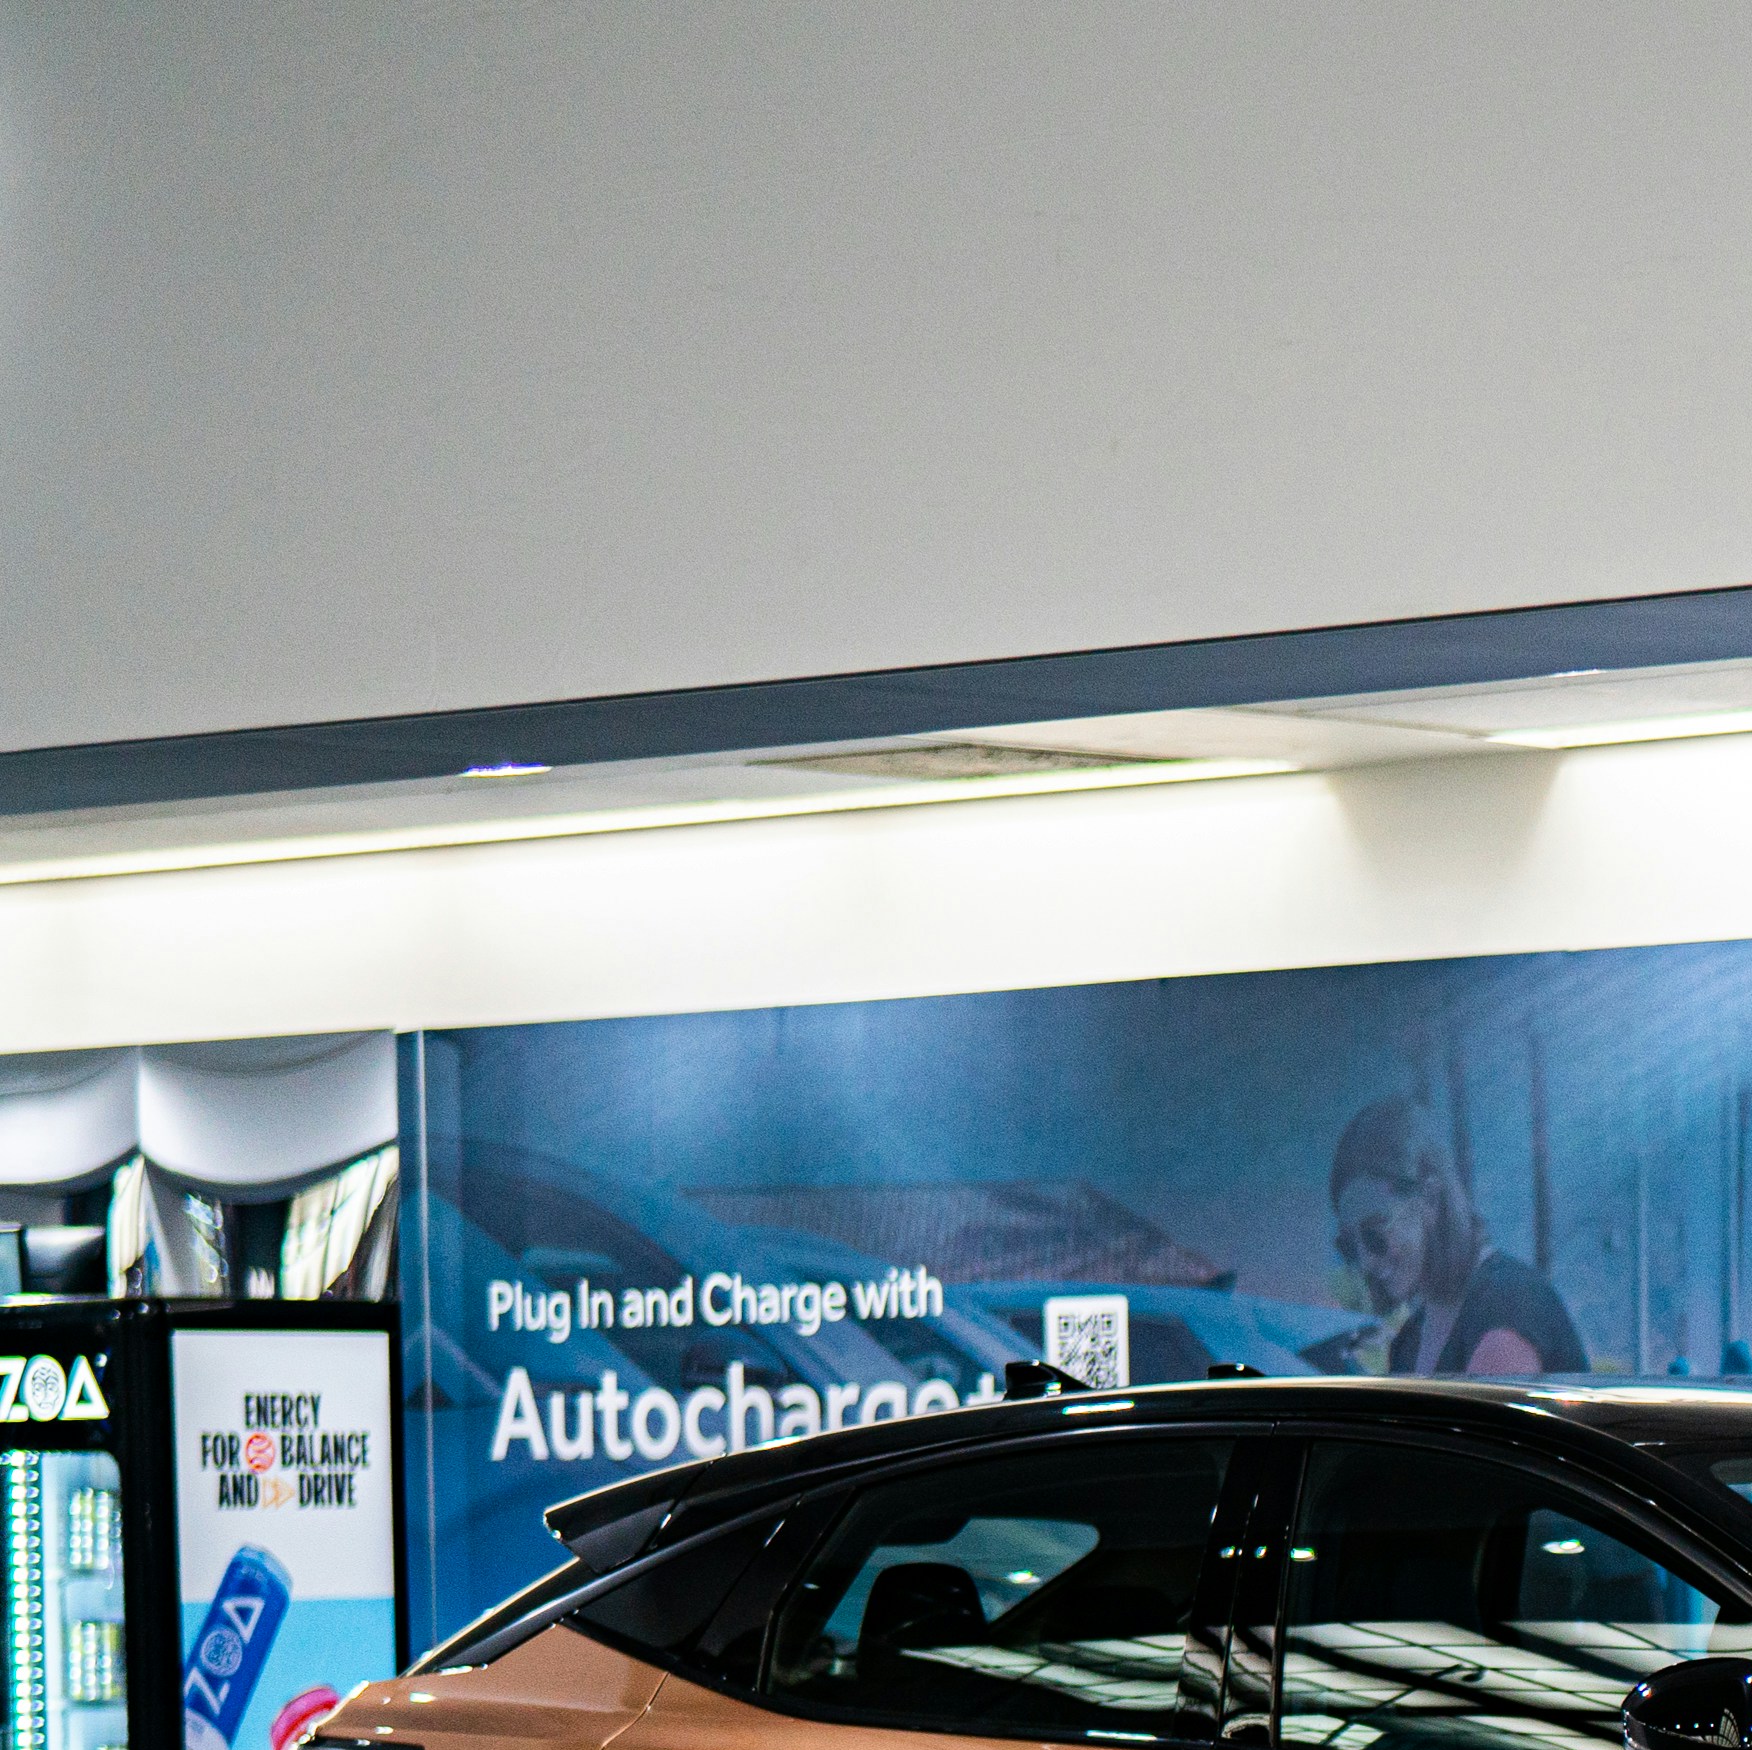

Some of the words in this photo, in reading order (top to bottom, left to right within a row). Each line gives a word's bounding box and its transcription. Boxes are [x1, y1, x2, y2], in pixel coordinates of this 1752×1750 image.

[487, 1279, 571, 1344] Plug
[577, 1277, 614, 1329] In
[620, 1275, 694, 1329] and
[700, 1271, 847, 1338] Charge
[853, 1263, 944, 1320] with
[244, 1393, 322, 1427] ENERGY
[201, 1433, 240, 1469] FOR
[280, 1432, 371, 1468] BALANCE
[218, 1472, 260, 1509] AND
[299, 1472, 357, 1508] DRIVE
